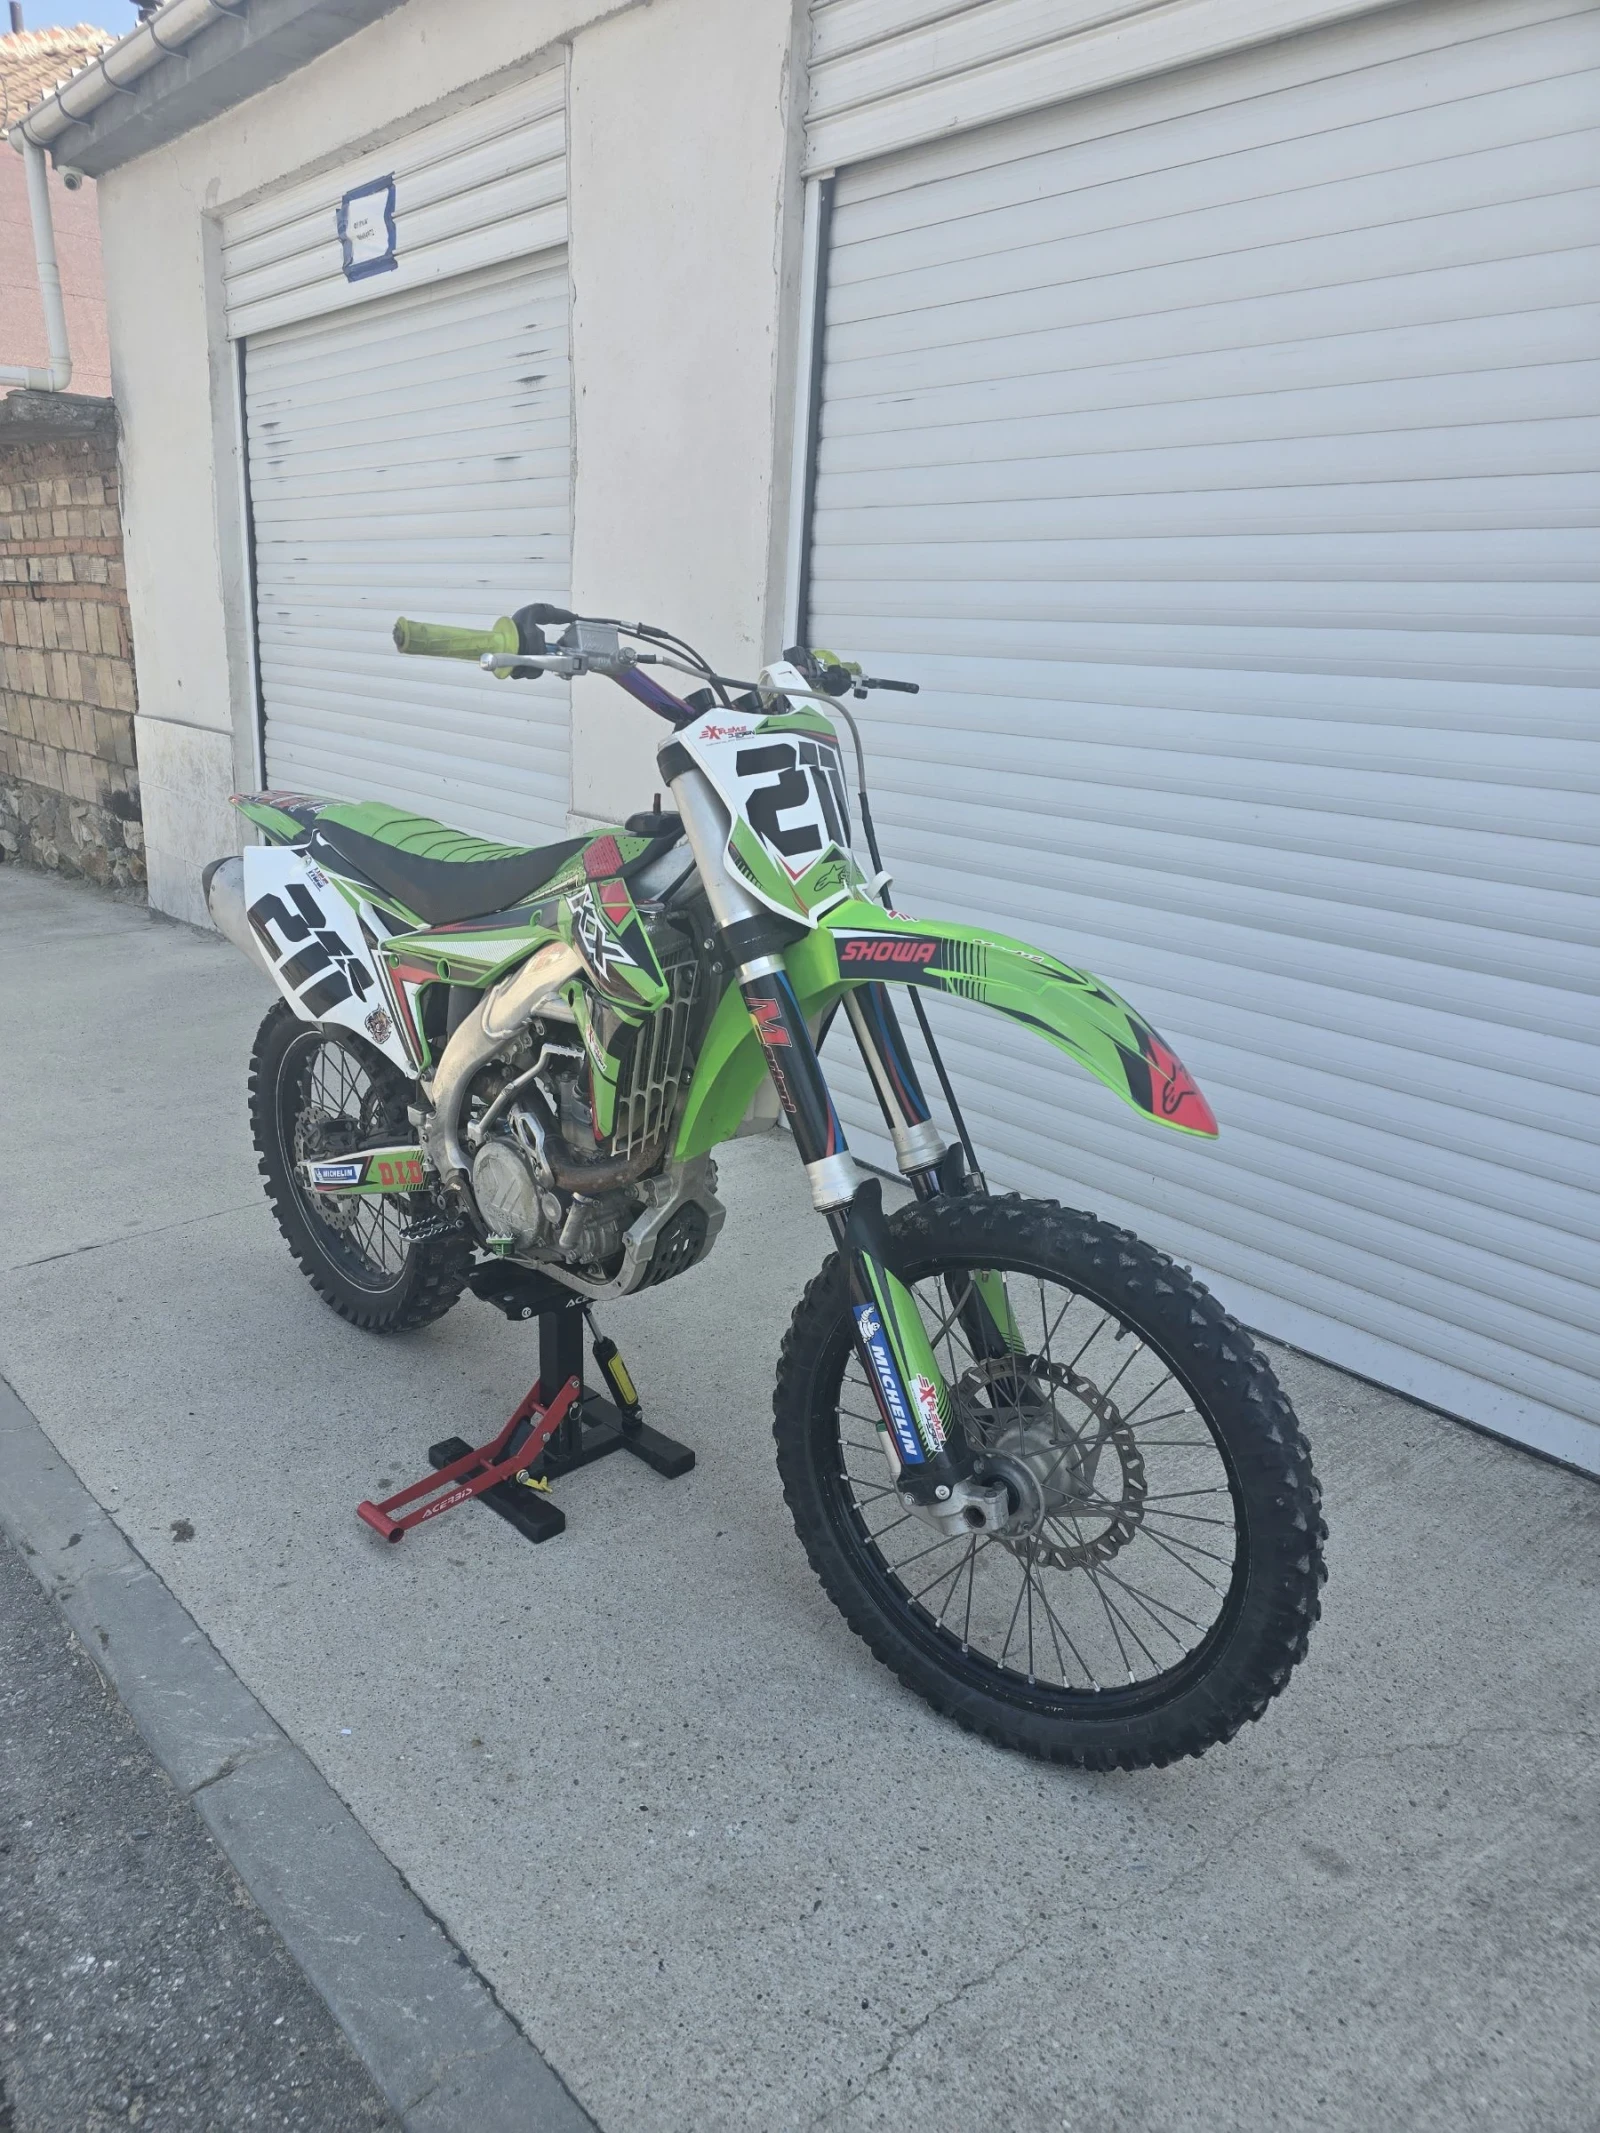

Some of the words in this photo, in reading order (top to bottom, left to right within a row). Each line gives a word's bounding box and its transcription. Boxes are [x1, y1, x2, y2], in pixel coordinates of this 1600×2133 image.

[841, 941, 937, 962] SHOWA
[322, 1168, 353, 1178] MICHELIN
[871, 1345, 917, 1456] MICHELIN
